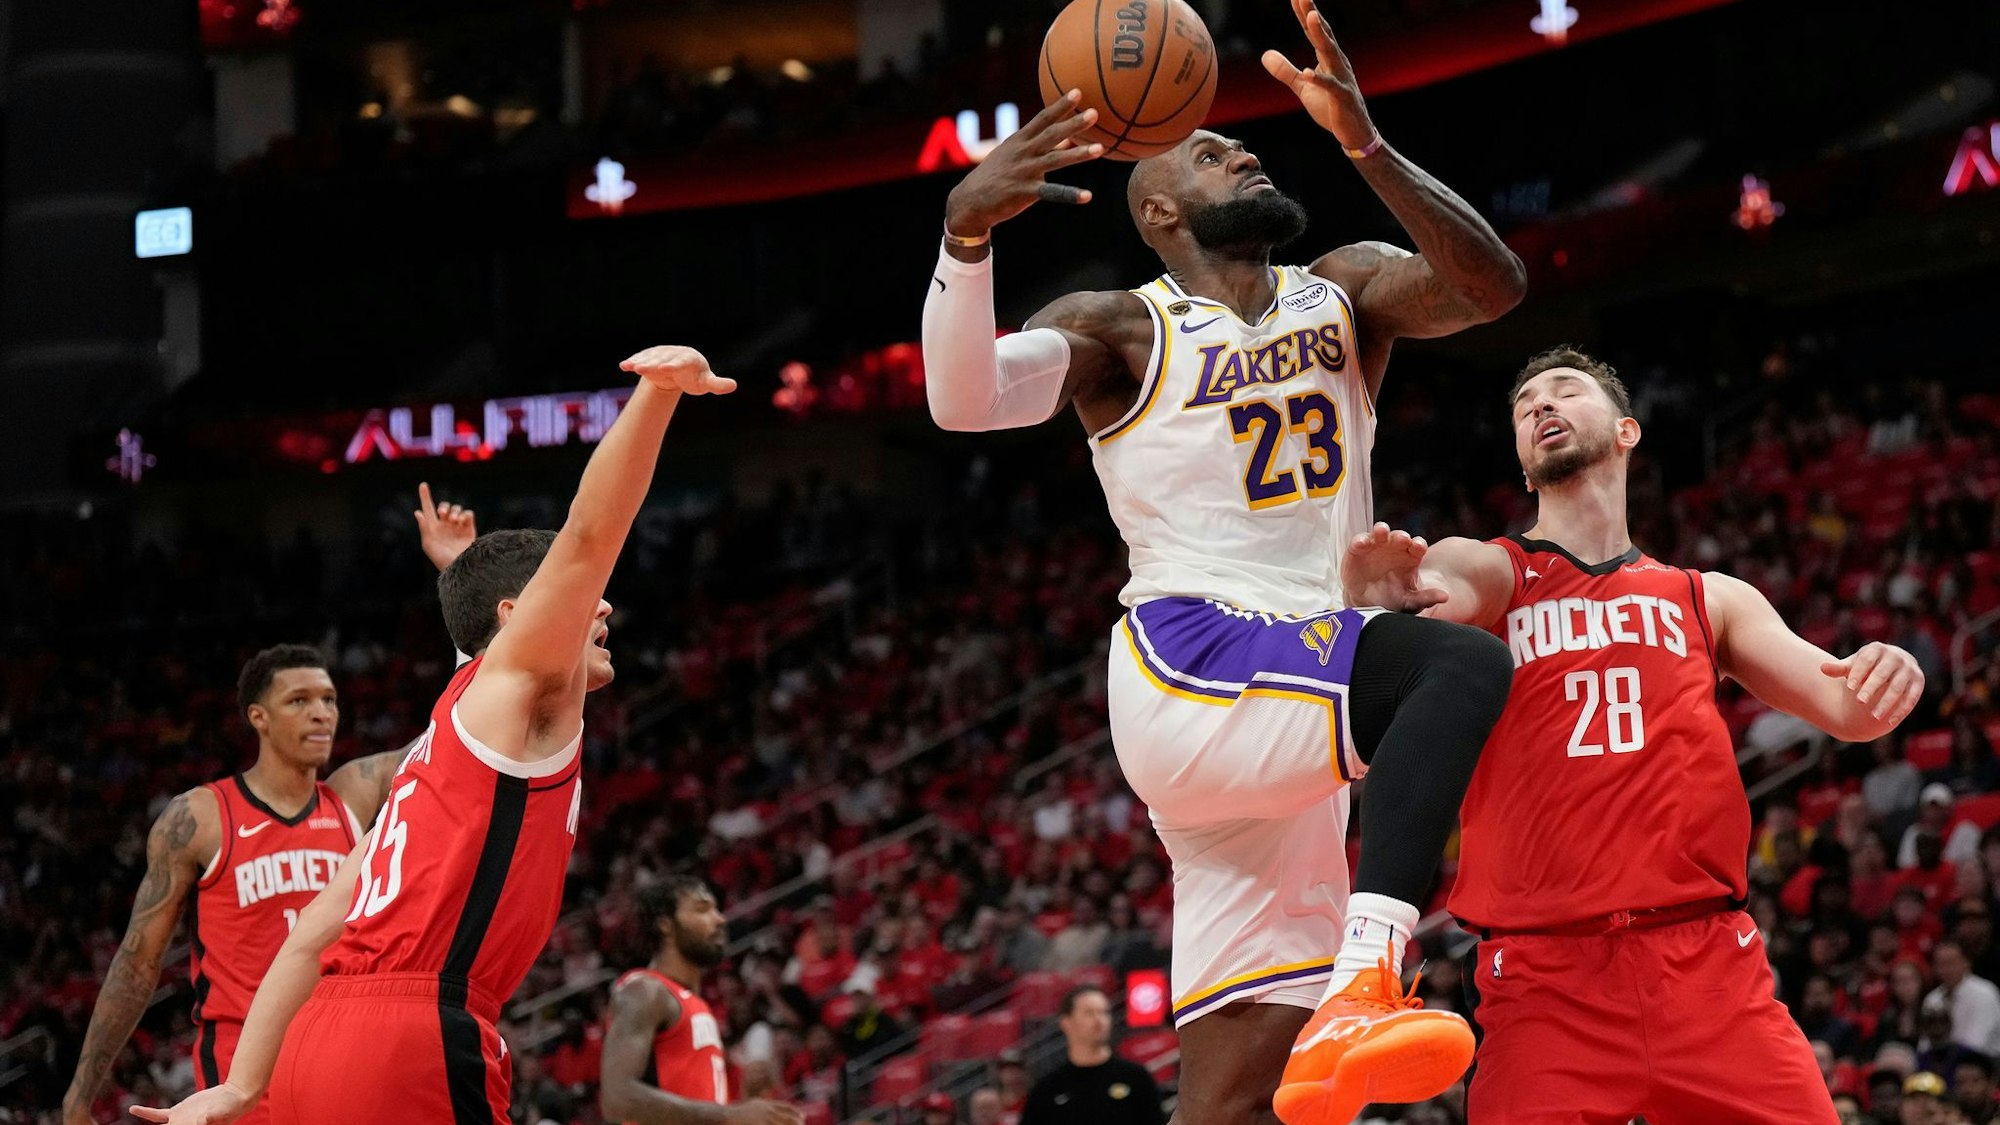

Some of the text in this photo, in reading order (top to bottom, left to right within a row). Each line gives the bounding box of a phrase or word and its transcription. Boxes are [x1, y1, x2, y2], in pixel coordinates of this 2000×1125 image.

[1284, 286, 1324, 307] bibigo
[1182, 321, 1346, 411] LAKERS
[1227, 389, 1347, 511] 23
[1506, 593, 1688, 669] ROCKETS
[1564, 666, 1645, 758] 28
[234, 848, 347, 909] ROCKET
